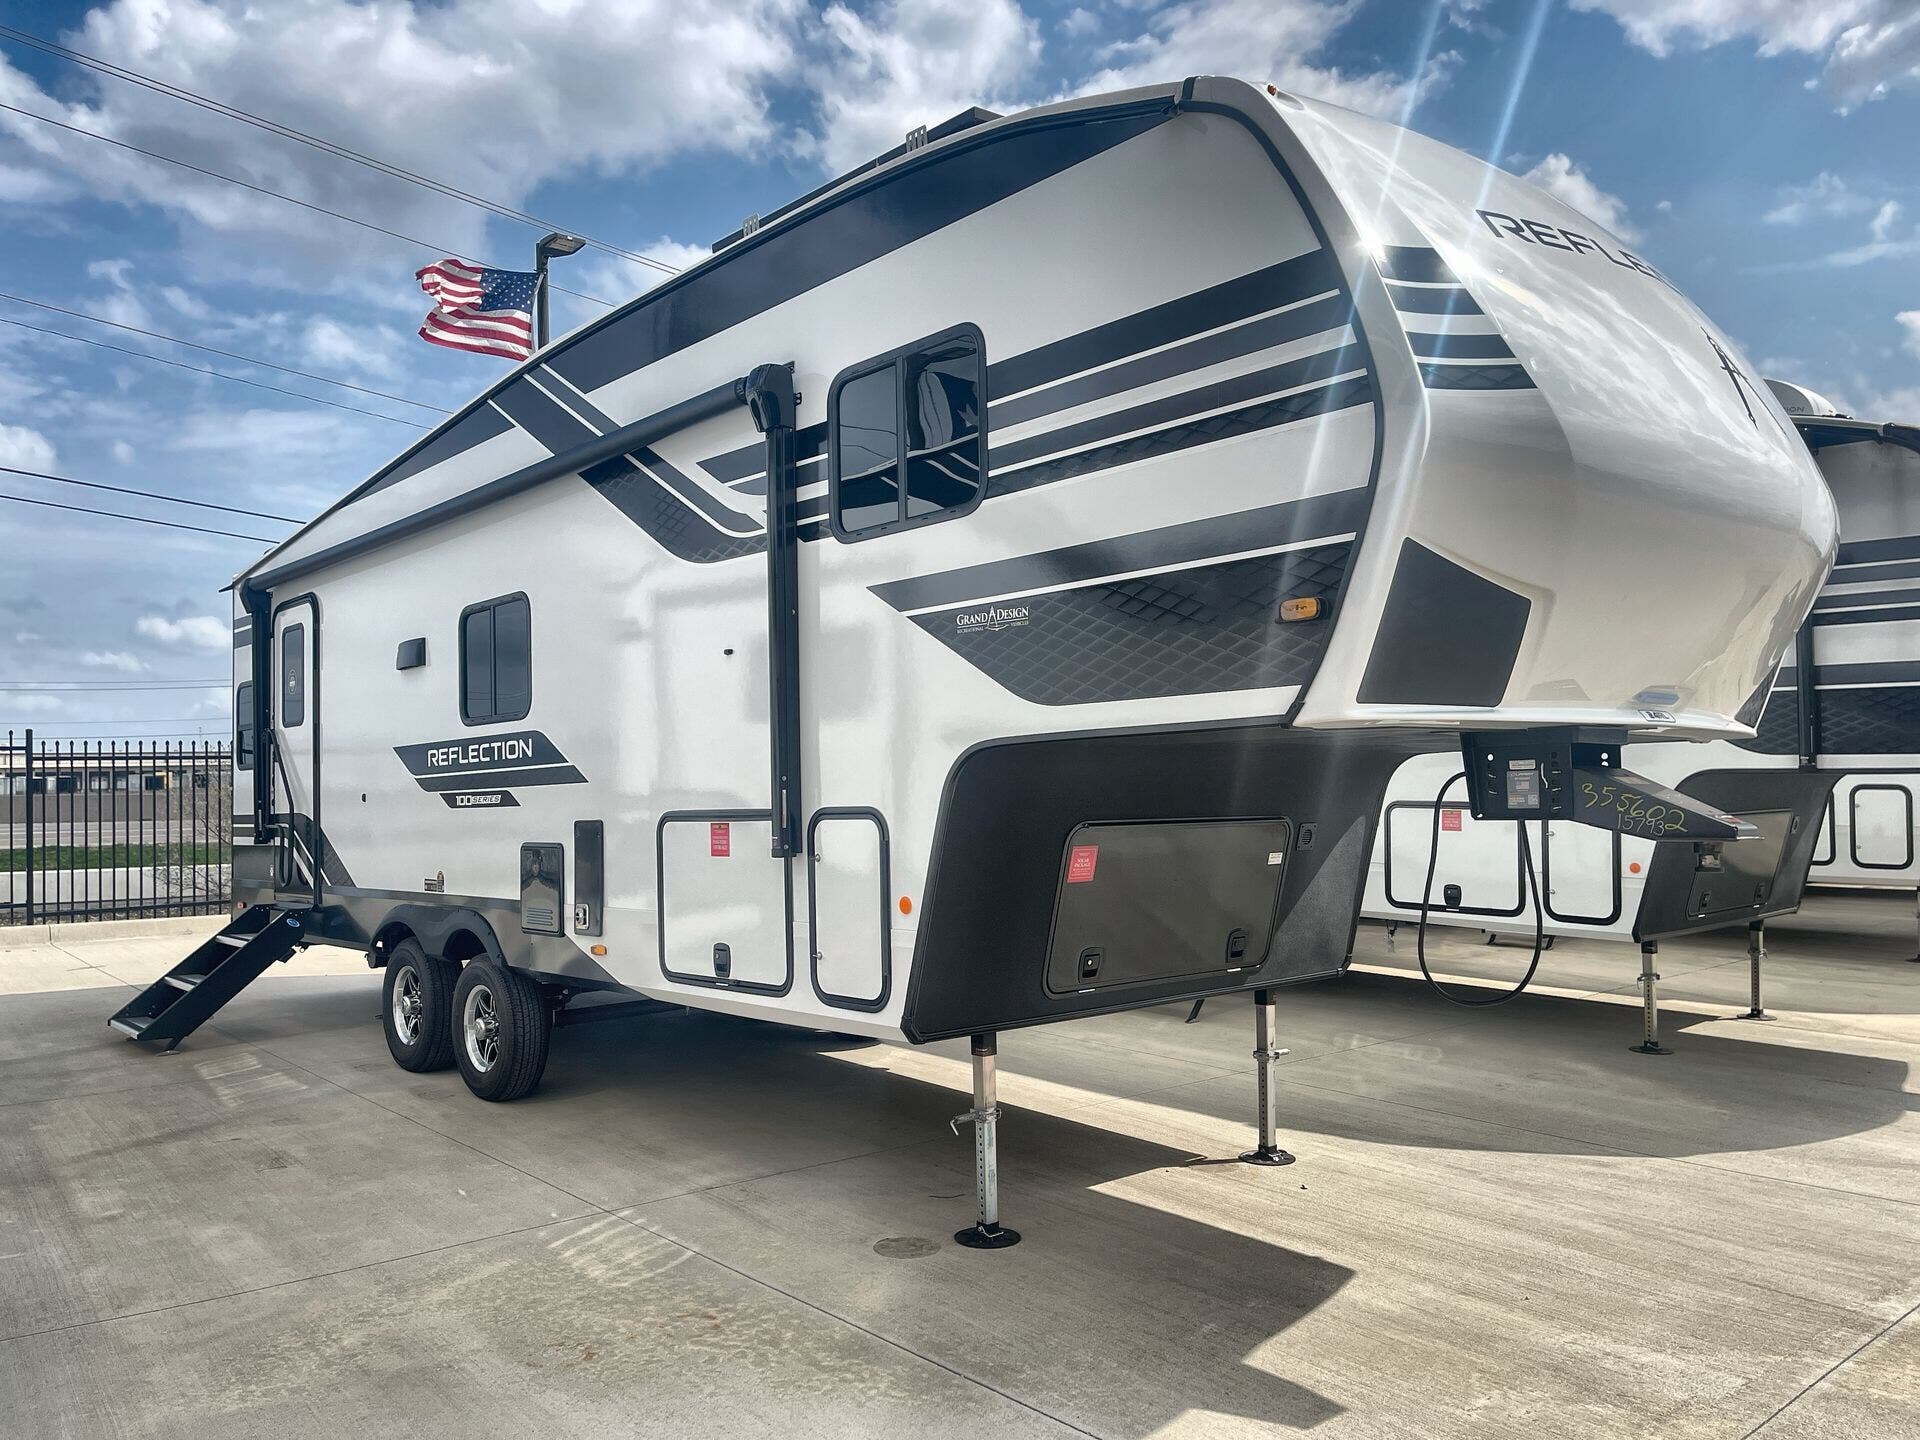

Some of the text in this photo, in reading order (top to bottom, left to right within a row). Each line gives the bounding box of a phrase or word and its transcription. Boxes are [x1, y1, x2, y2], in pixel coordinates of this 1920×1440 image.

[1475, 209, 1683, 297] REFLE
[957, 606, 1029, 625] GRAND DESIGN
[427, 738, 533, 767] REFLECTION
[472, 795, 501, 804] SERIES
[1617, 813, 1665, 837] 15793
